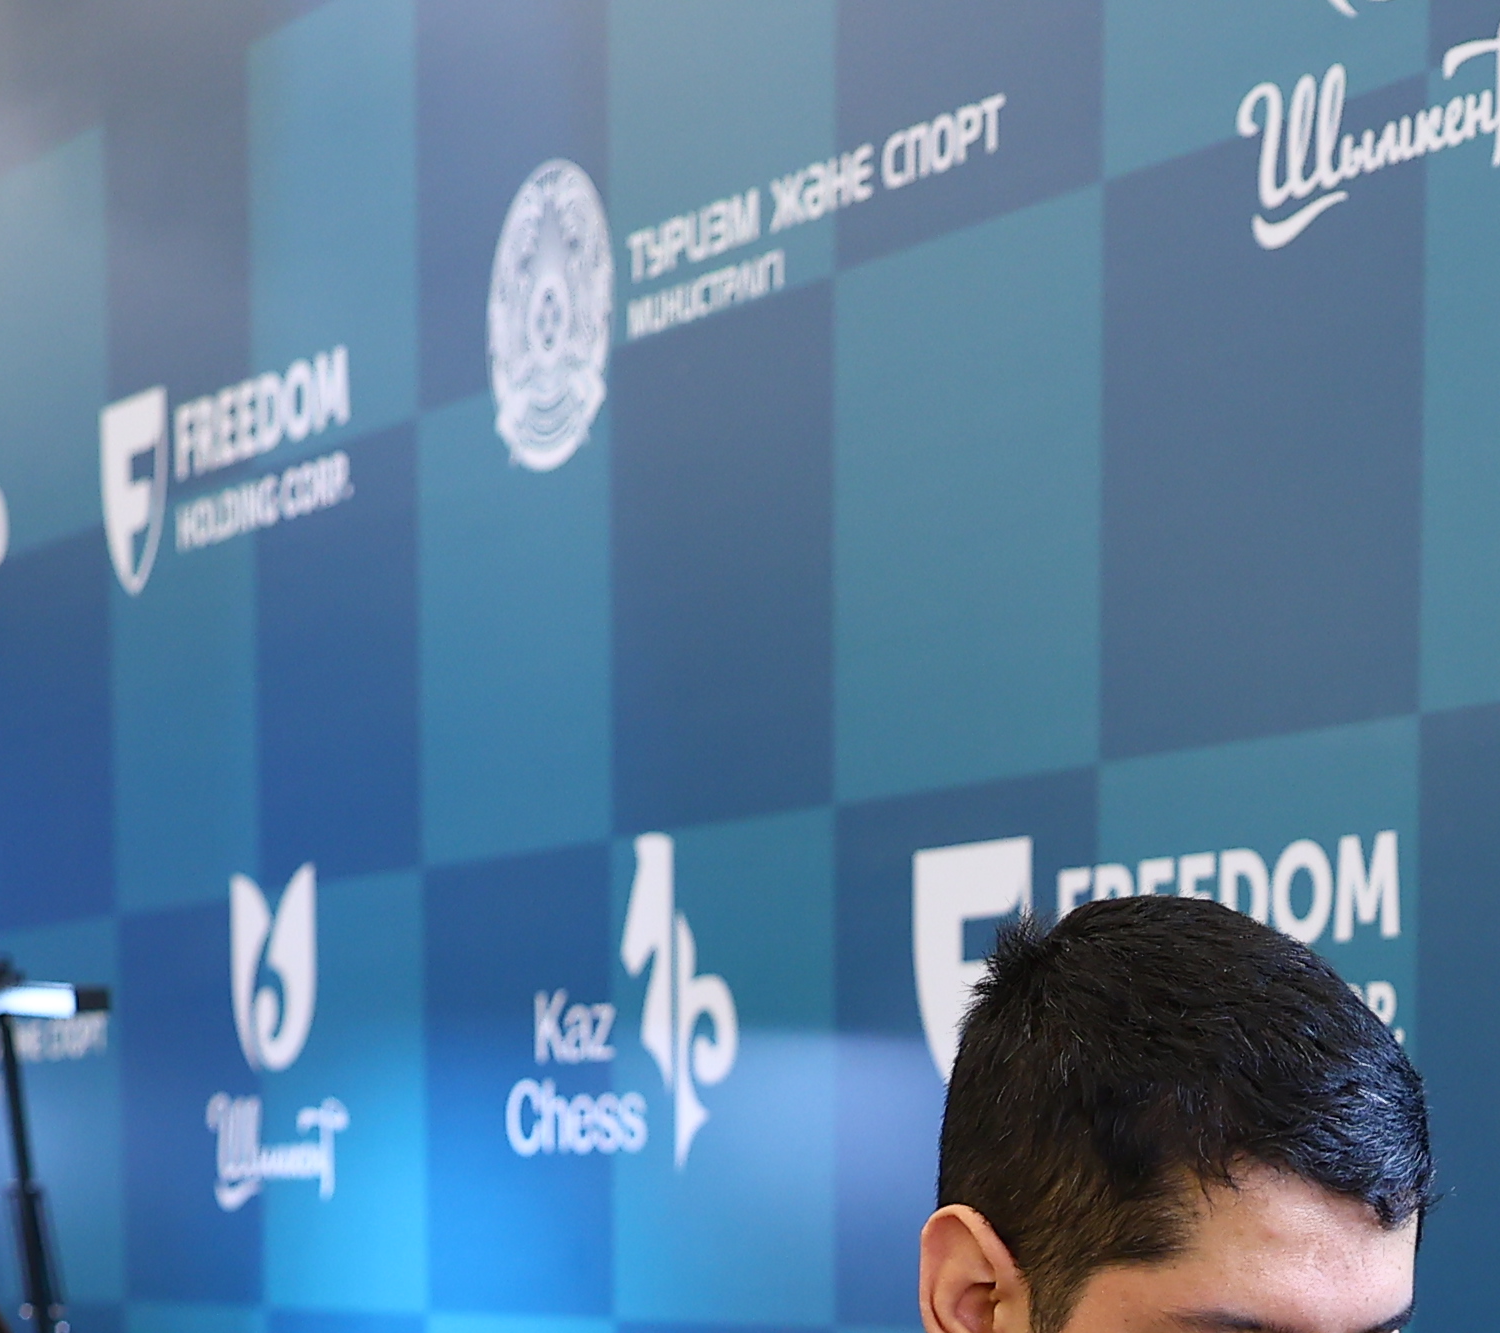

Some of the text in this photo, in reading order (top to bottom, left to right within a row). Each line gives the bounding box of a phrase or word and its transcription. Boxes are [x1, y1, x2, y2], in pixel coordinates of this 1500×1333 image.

[880, 92, 1007, 190] СПОРТ
[174, 343, 350, 483] FREEDOM
[533, 988, 619, 1065] Kaz
[505, 1076, 649, 1158] Chess
